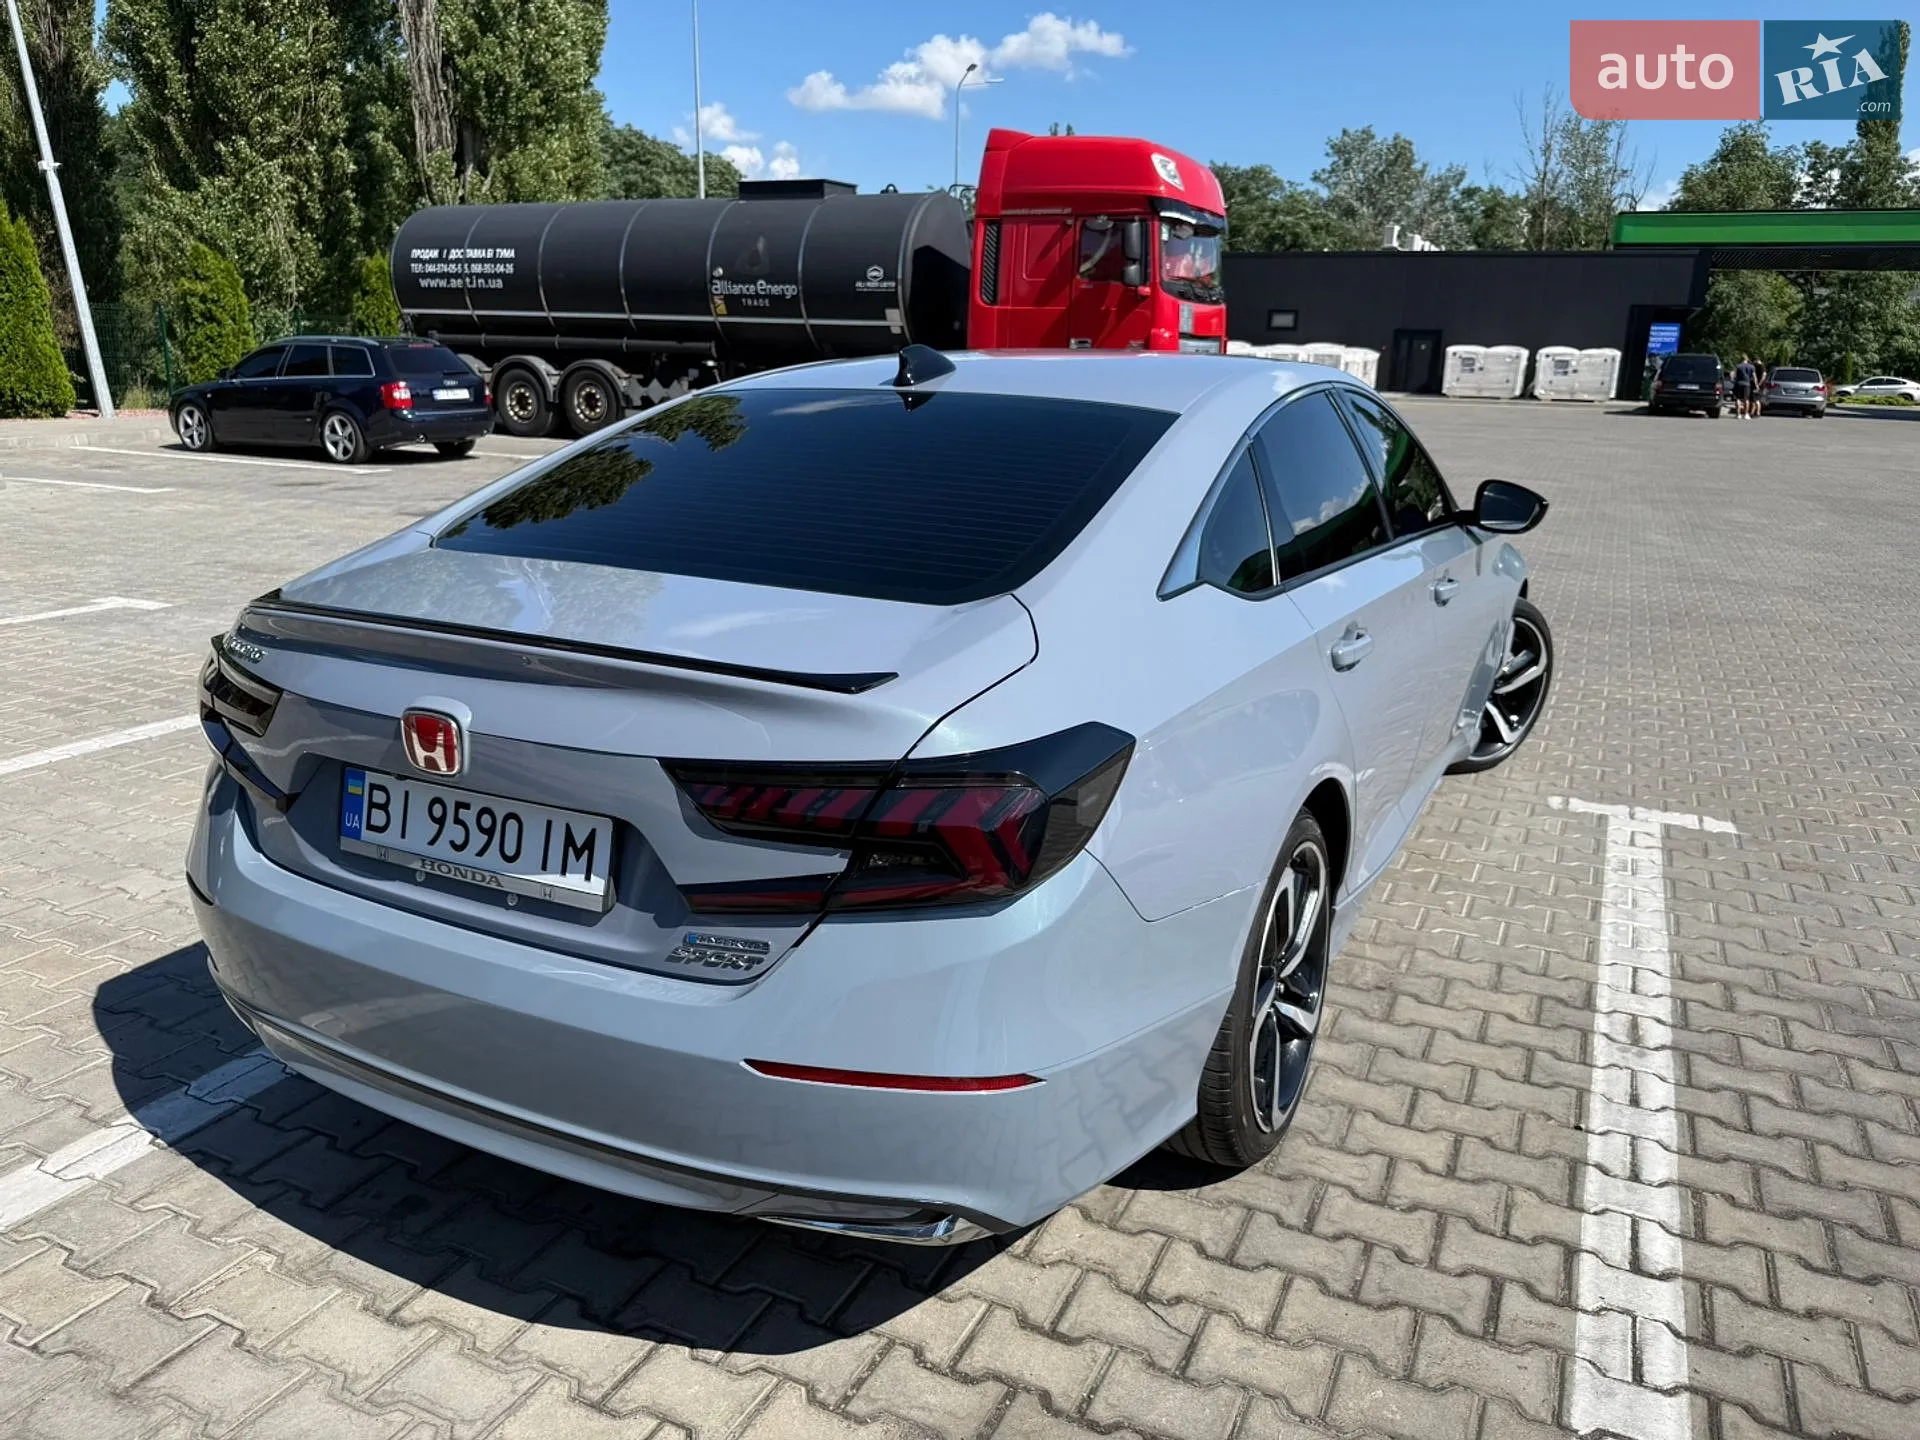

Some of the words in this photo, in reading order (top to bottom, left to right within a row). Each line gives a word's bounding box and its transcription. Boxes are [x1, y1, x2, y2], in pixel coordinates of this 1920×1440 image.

[345, 813, 360, 830] UA
[365, 782, 410, 840] BI
[427, 796, 523, 864] 9590
[541, 819, 597, 882] IM
[420, 858, 504, 888] HONDA
